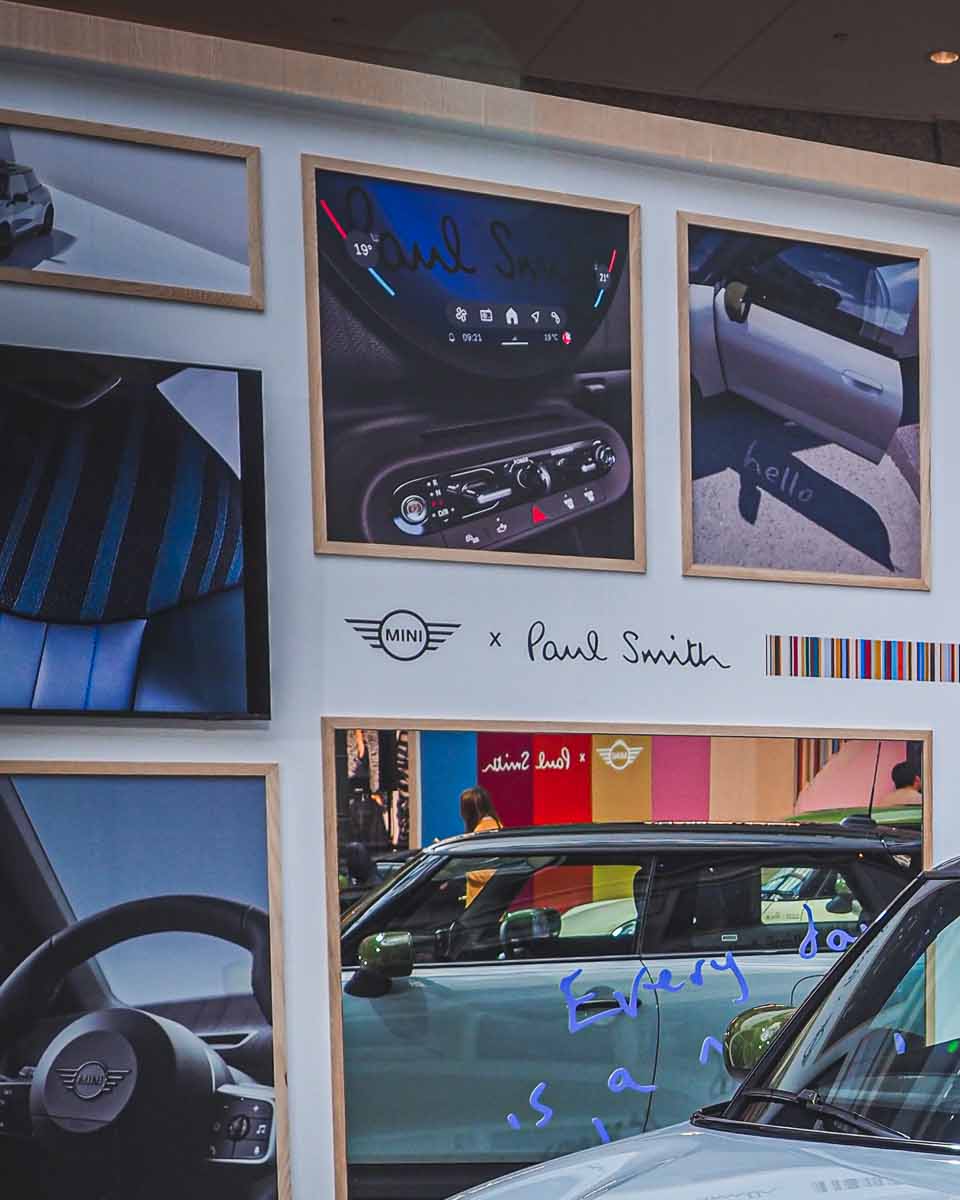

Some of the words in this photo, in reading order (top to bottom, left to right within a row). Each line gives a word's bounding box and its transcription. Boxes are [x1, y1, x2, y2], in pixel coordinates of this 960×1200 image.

[744, 440, 814, 502] hello
[385, 628, 423, 642] MINI
[527, 620, 608, 663] Paul
[622, 630, 732, 670] Smith
[559, 950, 750, 1034] Every
[799, 902, 869, 960] da
[78, 1074, 103, 1086] MINI
